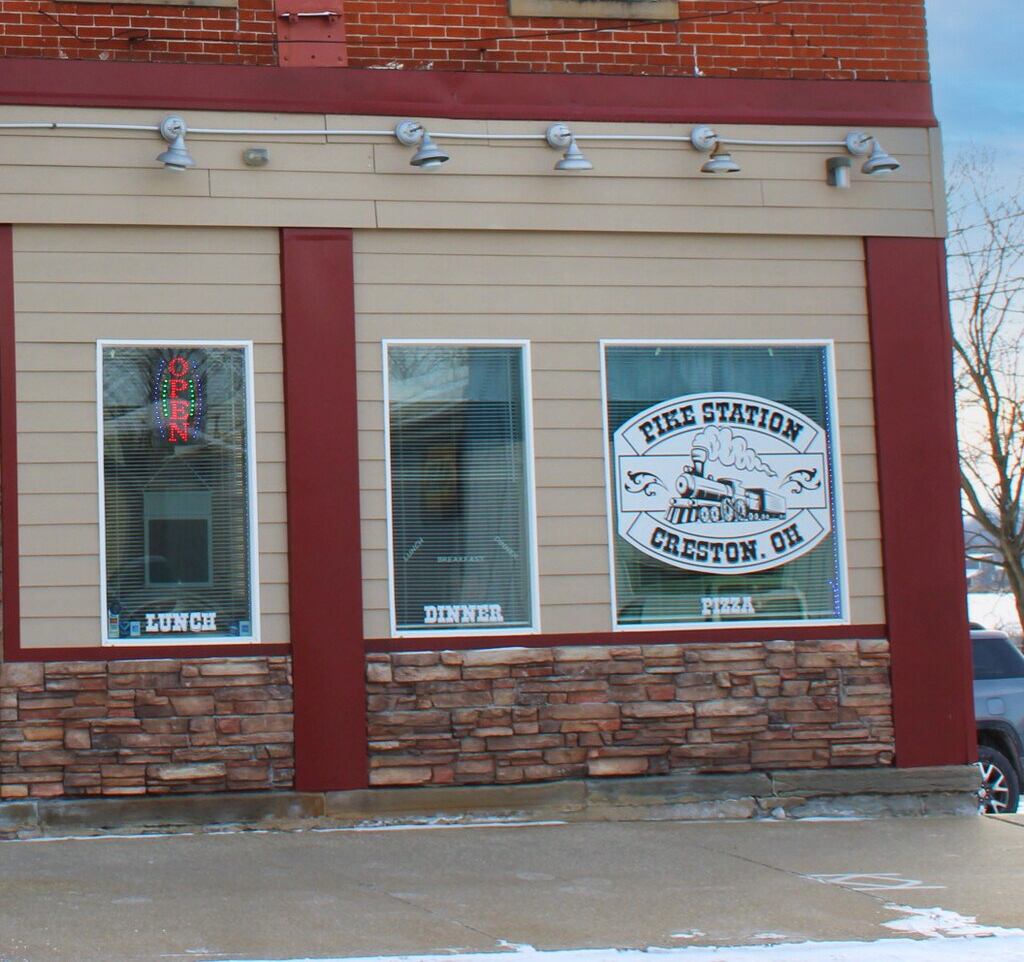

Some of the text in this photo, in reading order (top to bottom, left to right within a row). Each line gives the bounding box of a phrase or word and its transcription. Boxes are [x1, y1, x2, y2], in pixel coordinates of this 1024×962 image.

[168, 357, 190, 442] OPEN
[638, 402, 803, 444] PIKE STATION
[770, 523, 804, 554] OH
[423, 604, 504, 624] DINNER
[700, 596, 756, 615] PIZZA
[145, 612, 217, 632] LUNCH
